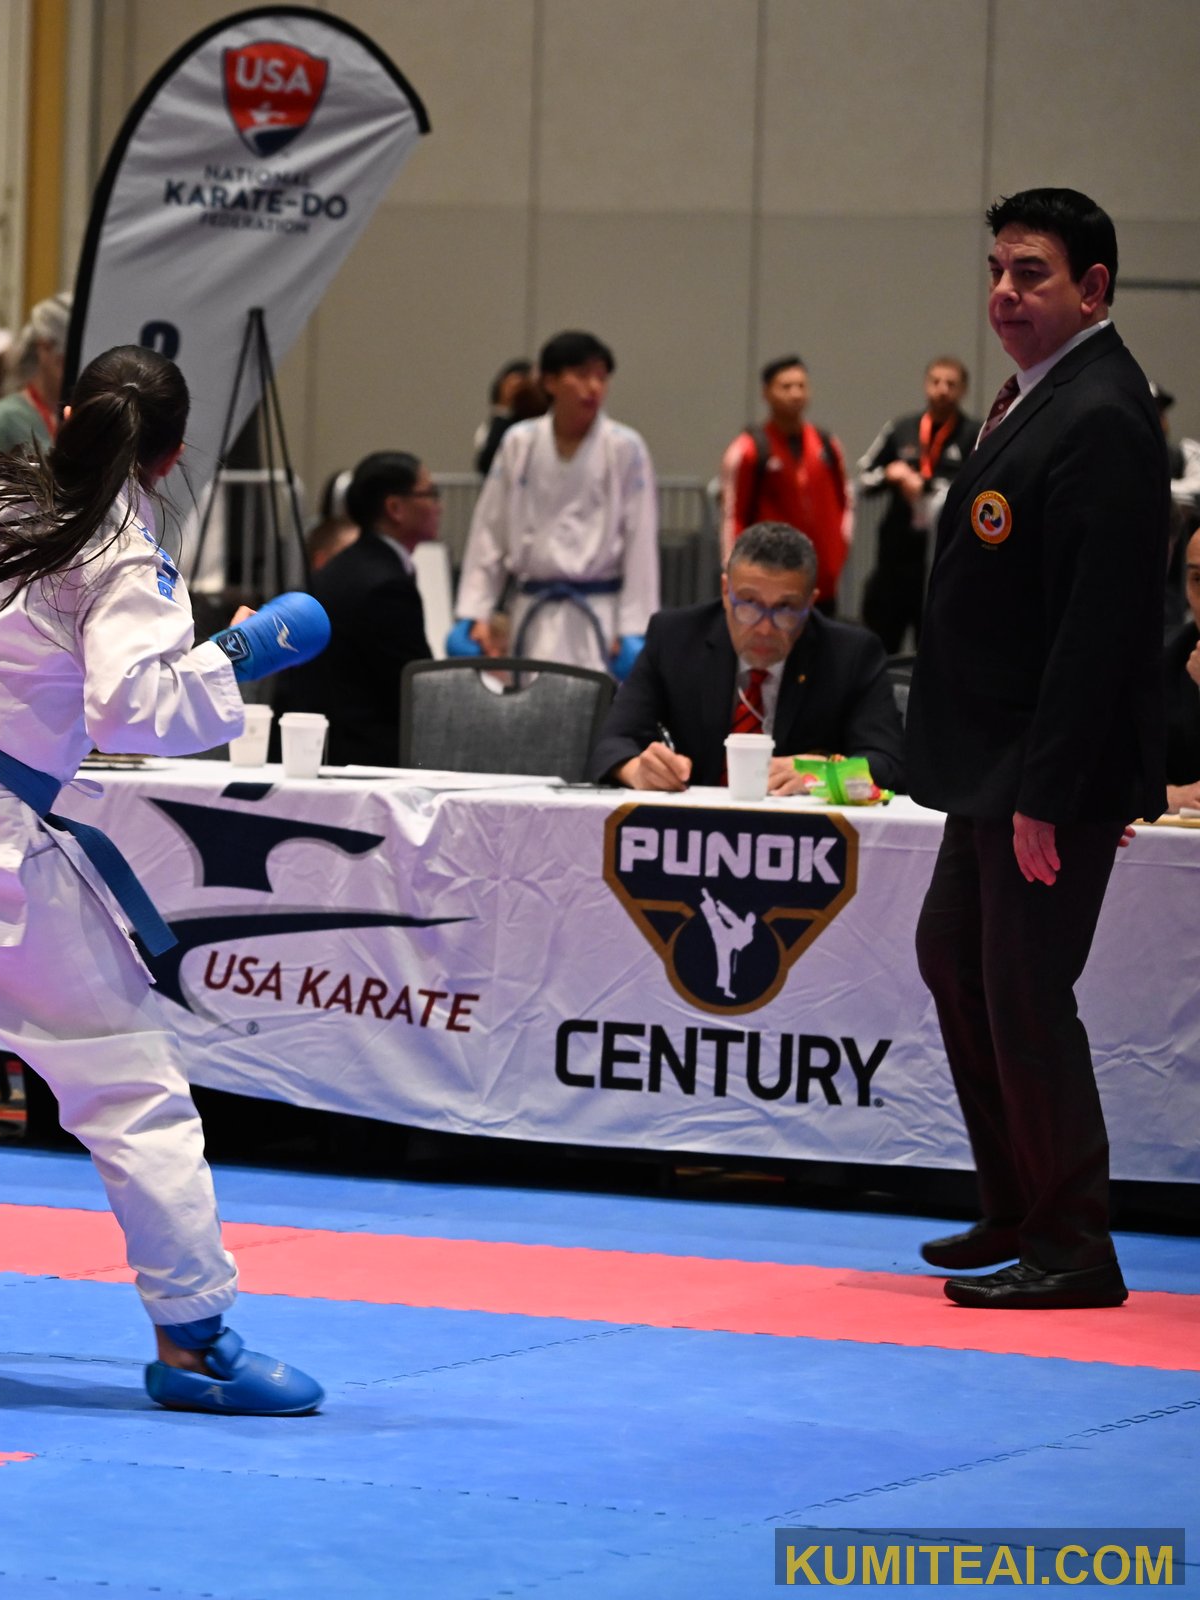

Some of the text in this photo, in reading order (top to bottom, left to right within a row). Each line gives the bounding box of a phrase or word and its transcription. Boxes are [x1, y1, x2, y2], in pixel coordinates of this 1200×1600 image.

[235, 56, 311, 96] USA
[163, 178, 348, 220] KARATE-DO
[619, 826, 841, 884] PUNOK
[204, 950, 480, 1033] USA KARATE
[554, 1018, 893, 1108] CENTURY
